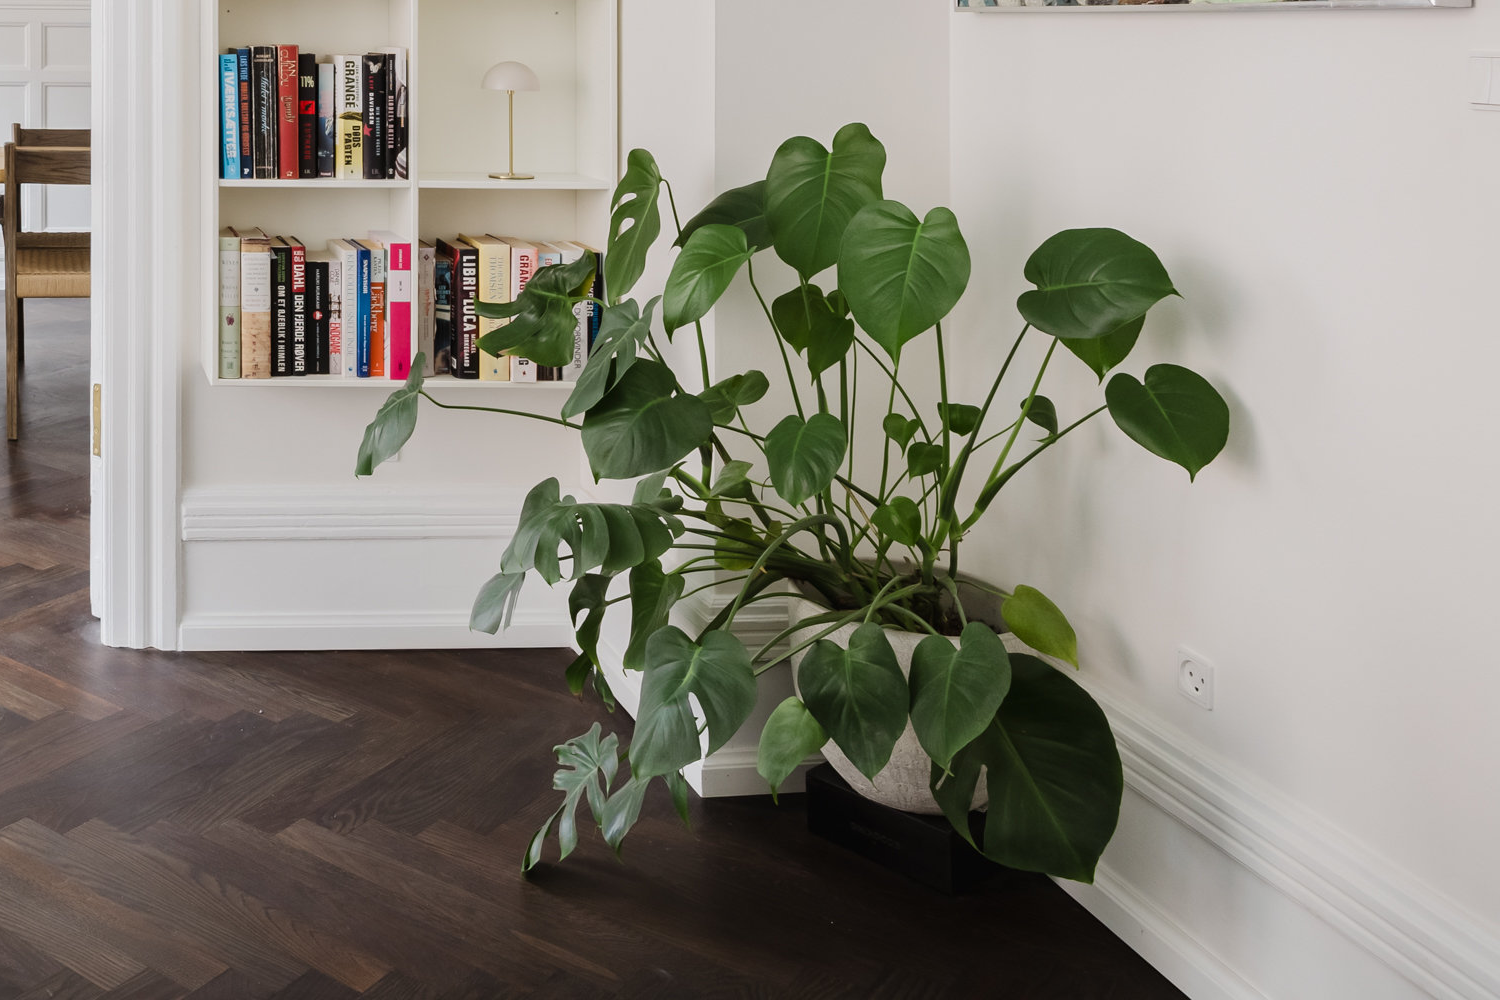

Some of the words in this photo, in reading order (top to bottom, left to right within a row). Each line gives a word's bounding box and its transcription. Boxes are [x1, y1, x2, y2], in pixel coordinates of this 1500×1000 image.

[240, 67, 248, 80] TVEDE
[280, 50, 289, 87] GUILLOU
[288, 60, 296, 78] JAN
[300, 76, 315, 88] 11%
[345, 60, 358, 108] GRANGÉ
[224, 72, 237, 158] IVÆRKSÆTTER
[344, 133, 352, 166] PAGTEN
[352, 125, 361, 148] DØDS
[293, 264, 304, 290] DAHL
[462, 255, 476, 290] LIBRI
[278, 285, 285, 297] OM
[278, 298, 286, 307] ET
[294, 294, 304, 312] DEN
[370, 286, 383, 333] Läckberg
[462, 298, 476, 332] LUCA
[278, 310, 286, 338] ØJEBLIK
[294, 314, 304, 342] FJERDE
[330, 322, 341, 355] ENDGAME
[278, 344, 286, 372] HIMLEN
[294, 343, 304, 372] RØVER
